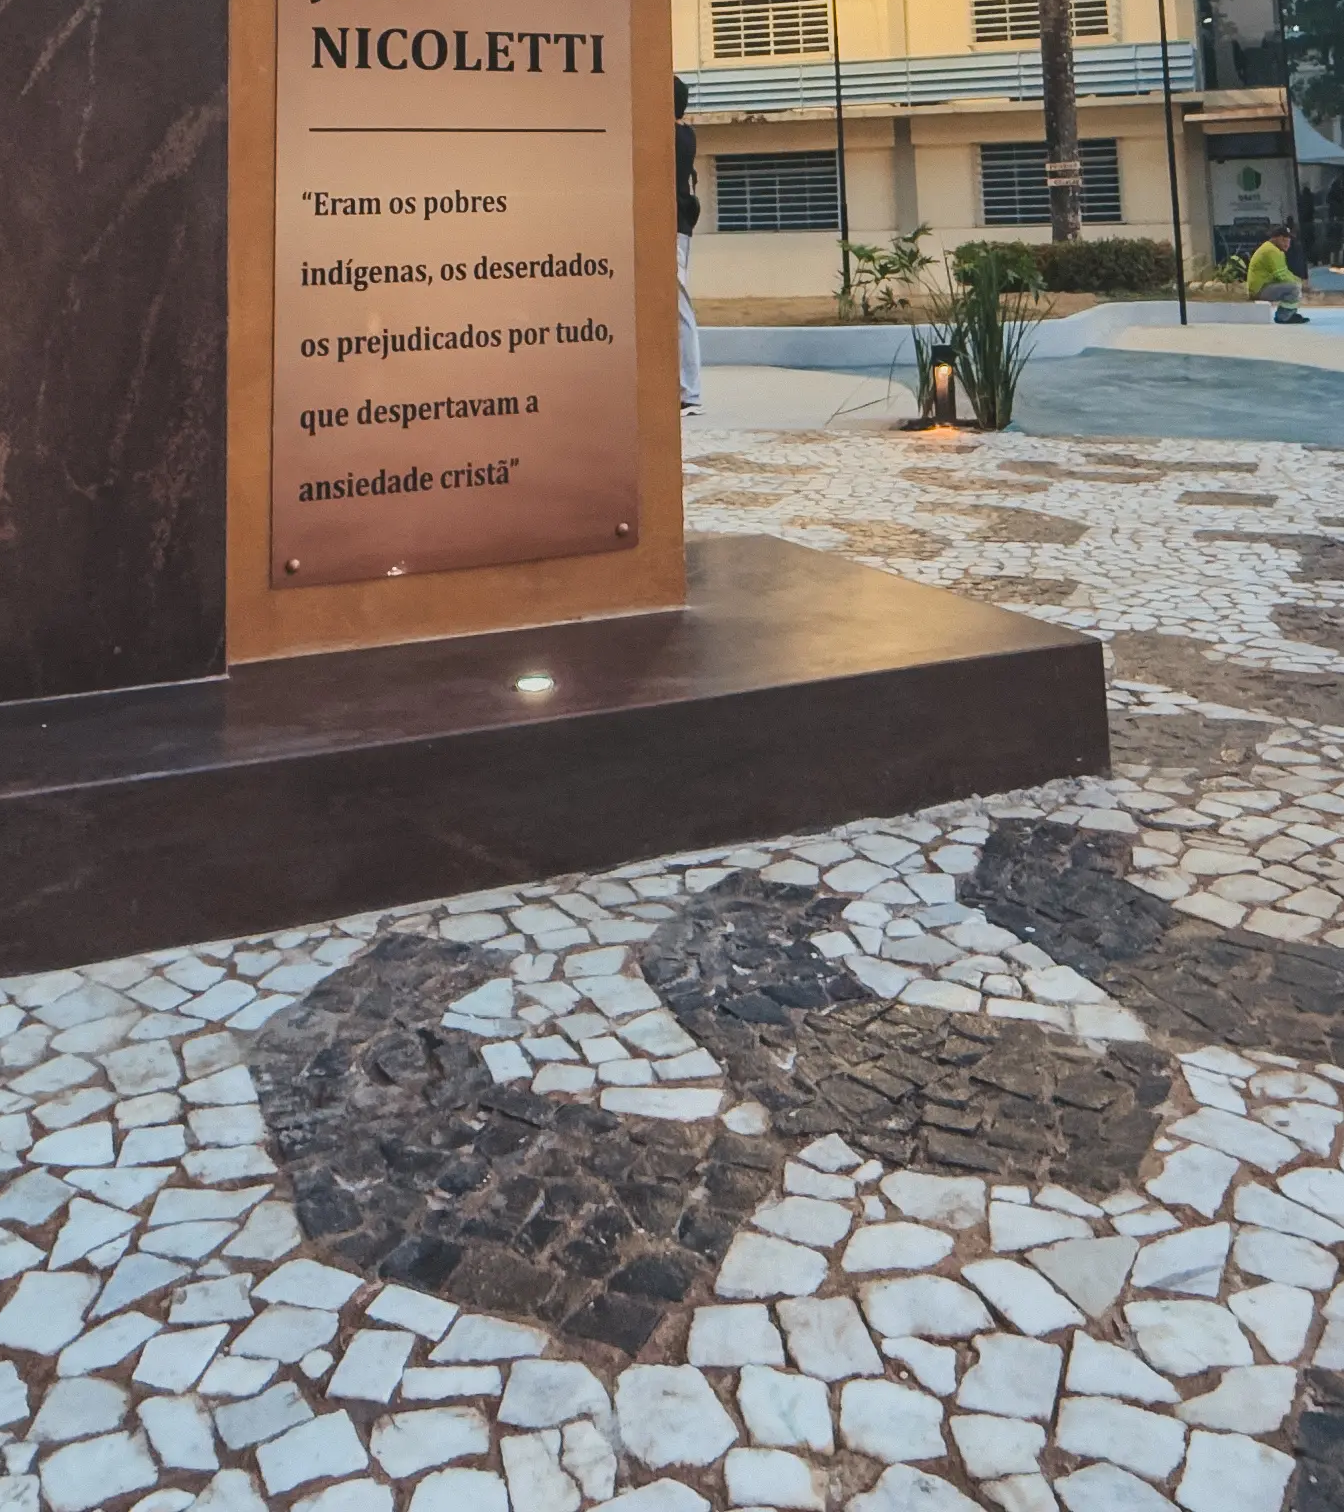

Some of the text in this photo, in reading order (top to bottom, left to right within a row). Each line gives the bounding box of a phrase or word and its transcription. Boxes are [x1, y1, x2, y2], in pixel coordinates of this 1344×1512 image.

[311, 26, 606, 75] NICOLETTI
[301, 189, 508, 221] “Eram os pobres
[300, 252, 614, 292] indígenas, os deserdados,
[300, 317, 614, 363] os prejudicados por tudo,
[300, 395, 540, 437] que despertavam a
[298, 457, 520, 503] ansiedade cristã”
